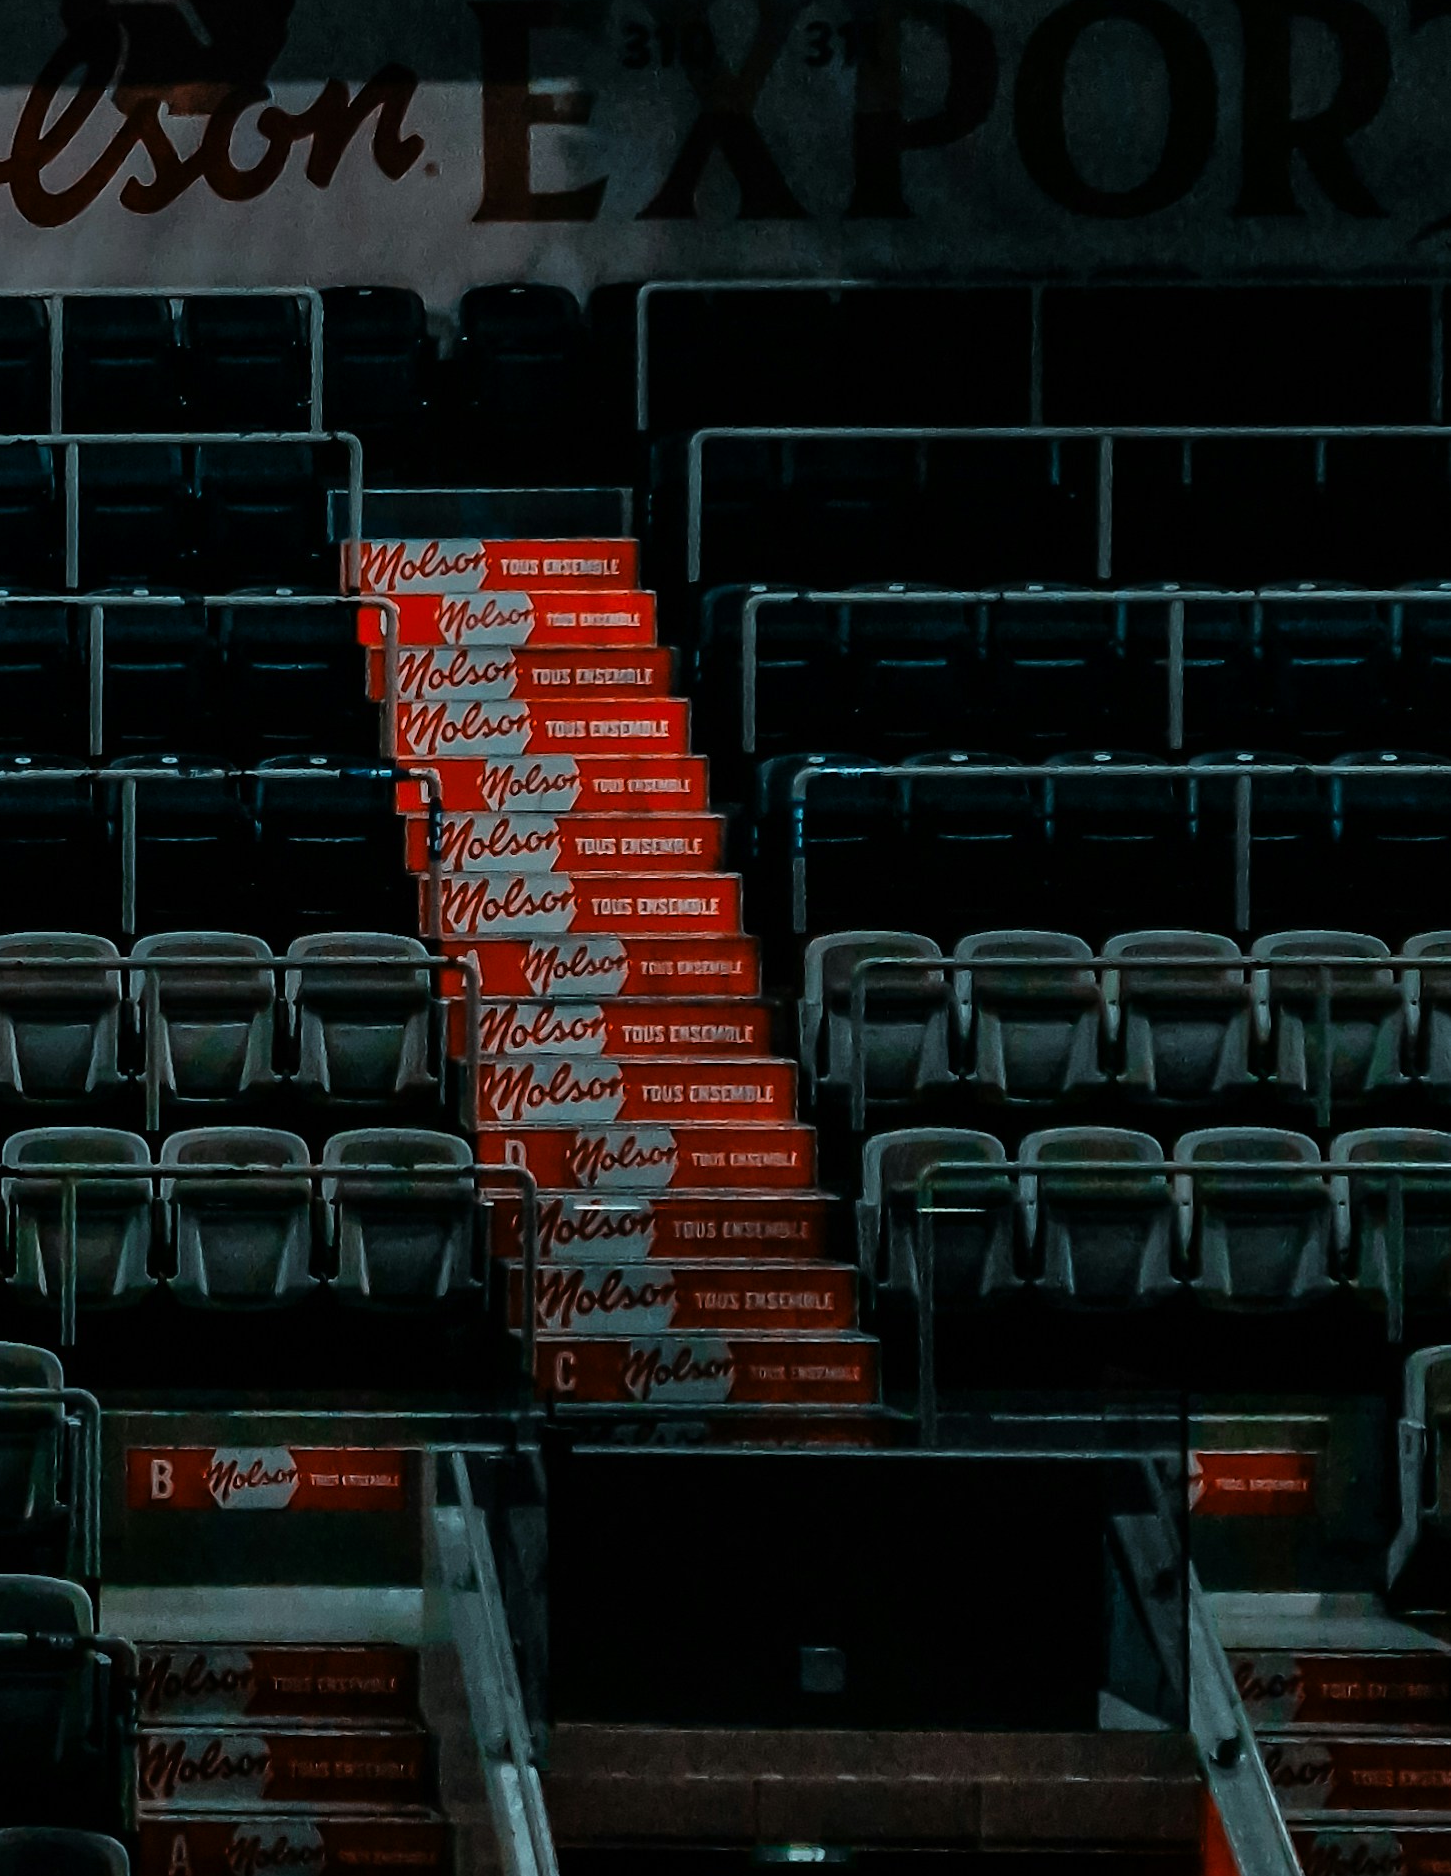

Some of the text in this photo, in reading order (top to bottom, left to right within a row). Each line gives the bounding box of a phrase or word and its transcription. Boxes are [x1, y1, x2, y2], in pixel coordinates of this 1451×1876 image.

[361, 541, 620, 591] Molson TOUS ENSEMBLE
[435, 599, 537, 644] Molson
[532, 668, 571, 685] TOUS
[576, 668, 653, 685] ENSEMBLE
[400, 702, 669, 754] Molson TOUS ENSEMBLE
[478, 763, 584, 810] Molson
[576, 837, 616, 855] TOUS
[621, 837, 703, 855] ENSEMBLE
[591, 897, 632, 916] TOUS
[637, 897, 720, 916] ENSEMBLE
[520, 946, 629, 996] Molson
[623, 1024, 664, 1043] TOUS
[483, 1063, 627, 1120] Molson
[642, 1084, 684, 1103] TOUS
[566, 1135, 679, 1185] Molson
[553, 1349, 577, 1394] C
[620, 1348, 737, 1400] Molson
[149, 1459, 175, 1501] B
[204, 1460, 301, 1500] Molson
